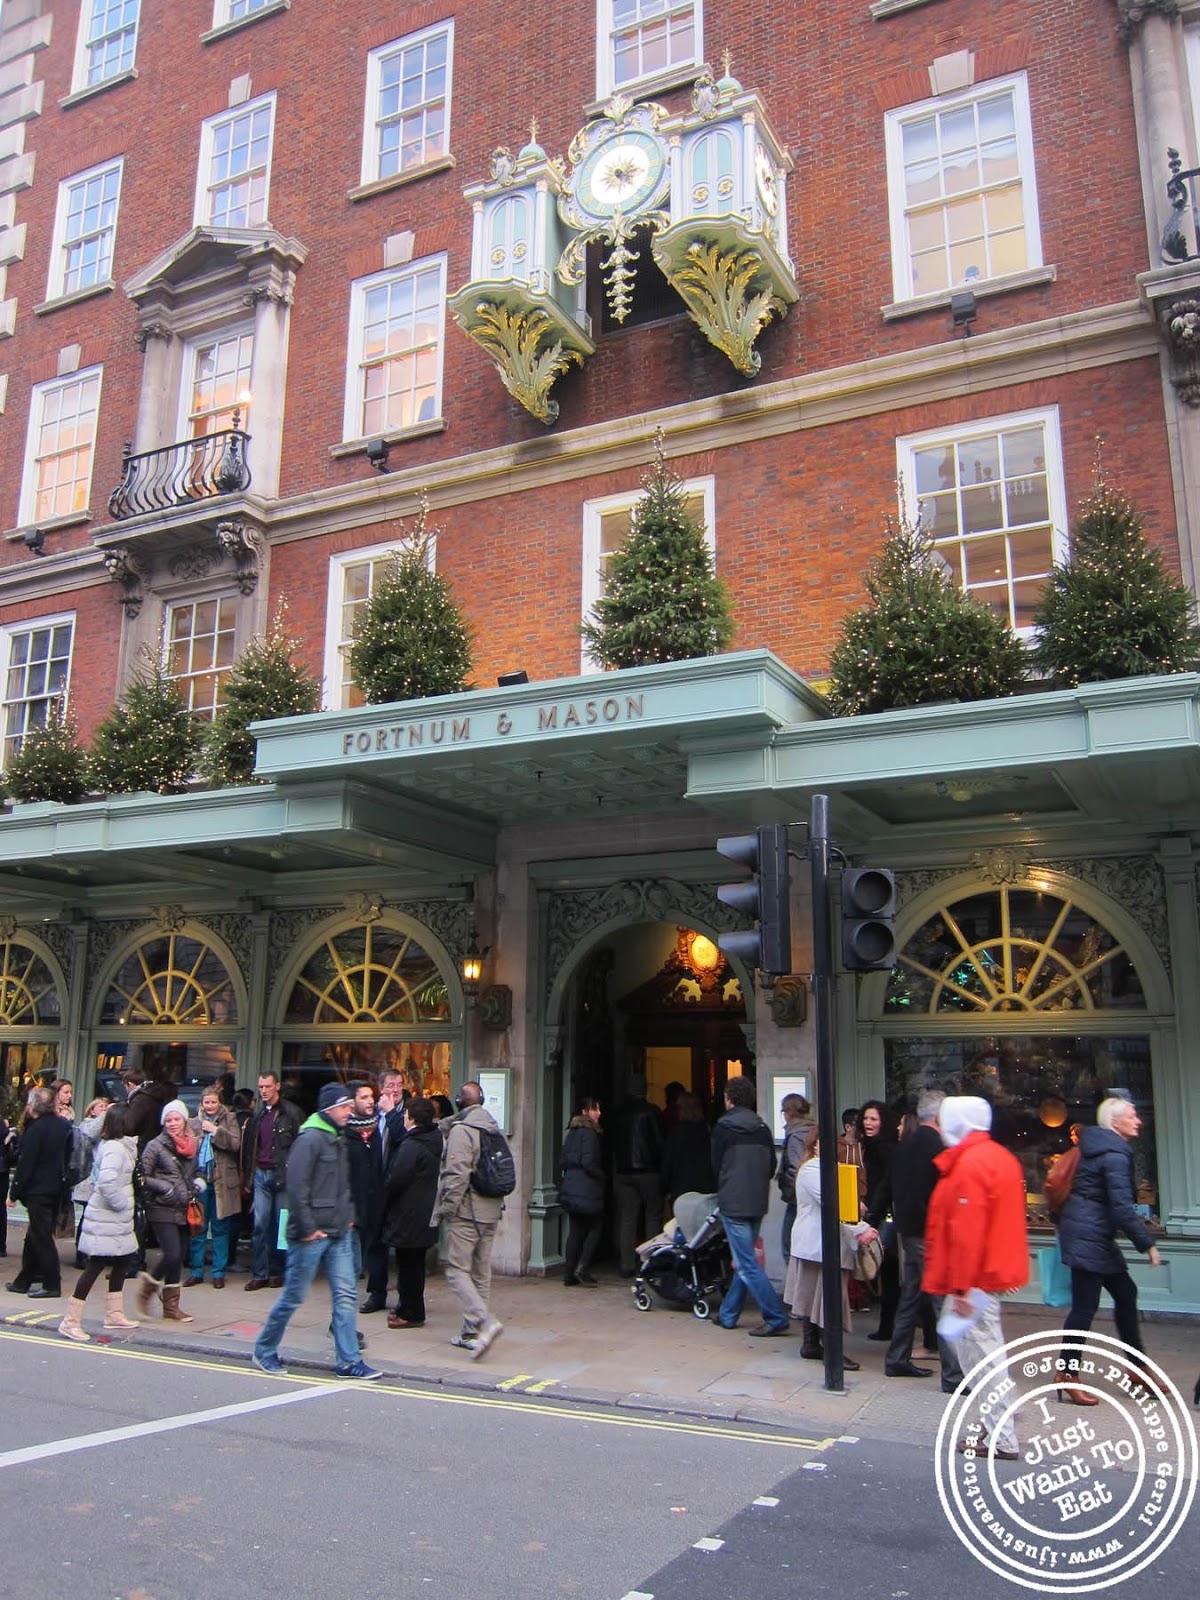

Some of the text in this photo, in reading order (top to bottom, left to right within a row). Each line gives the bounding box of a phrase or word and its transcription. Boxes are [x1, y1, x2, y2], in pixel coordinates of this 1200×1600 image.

[342, 694, 645, 754] FORTNUM & MASON
